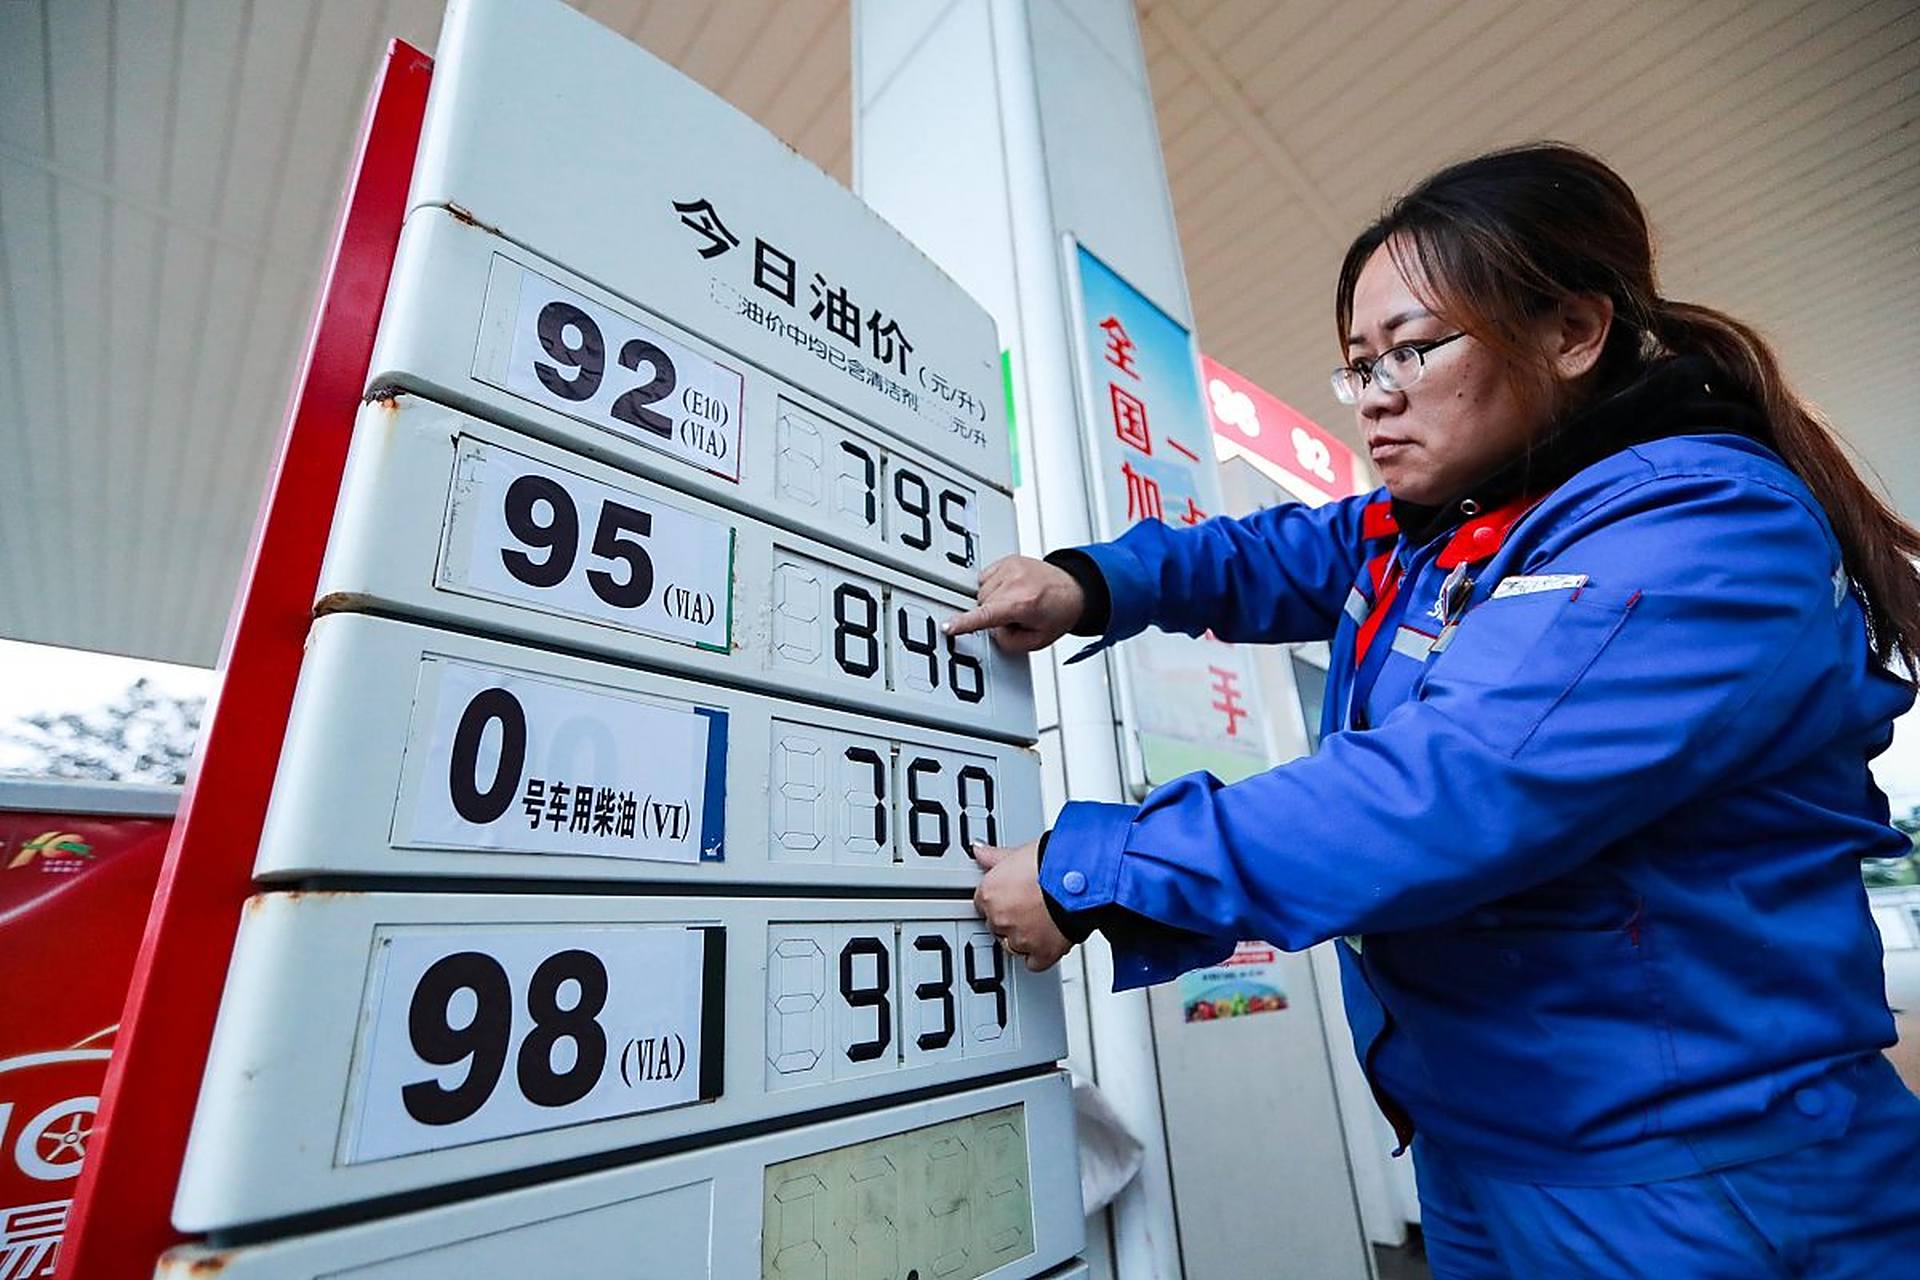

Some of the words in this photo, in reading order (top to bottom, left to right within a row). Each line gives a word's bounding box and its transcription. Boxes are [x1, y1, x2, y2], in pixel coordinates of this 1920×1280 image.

[672, 197, 914, 375] 今日油价
[535, 302, 677, 439] 92
[501, 475, 655, 609] 95
[840, 441, 975, 567] 795
[844, 746, 998, 859] 760
[401, 949, 609, 1126] 98
[839, 934, 1008, 1062] 934
